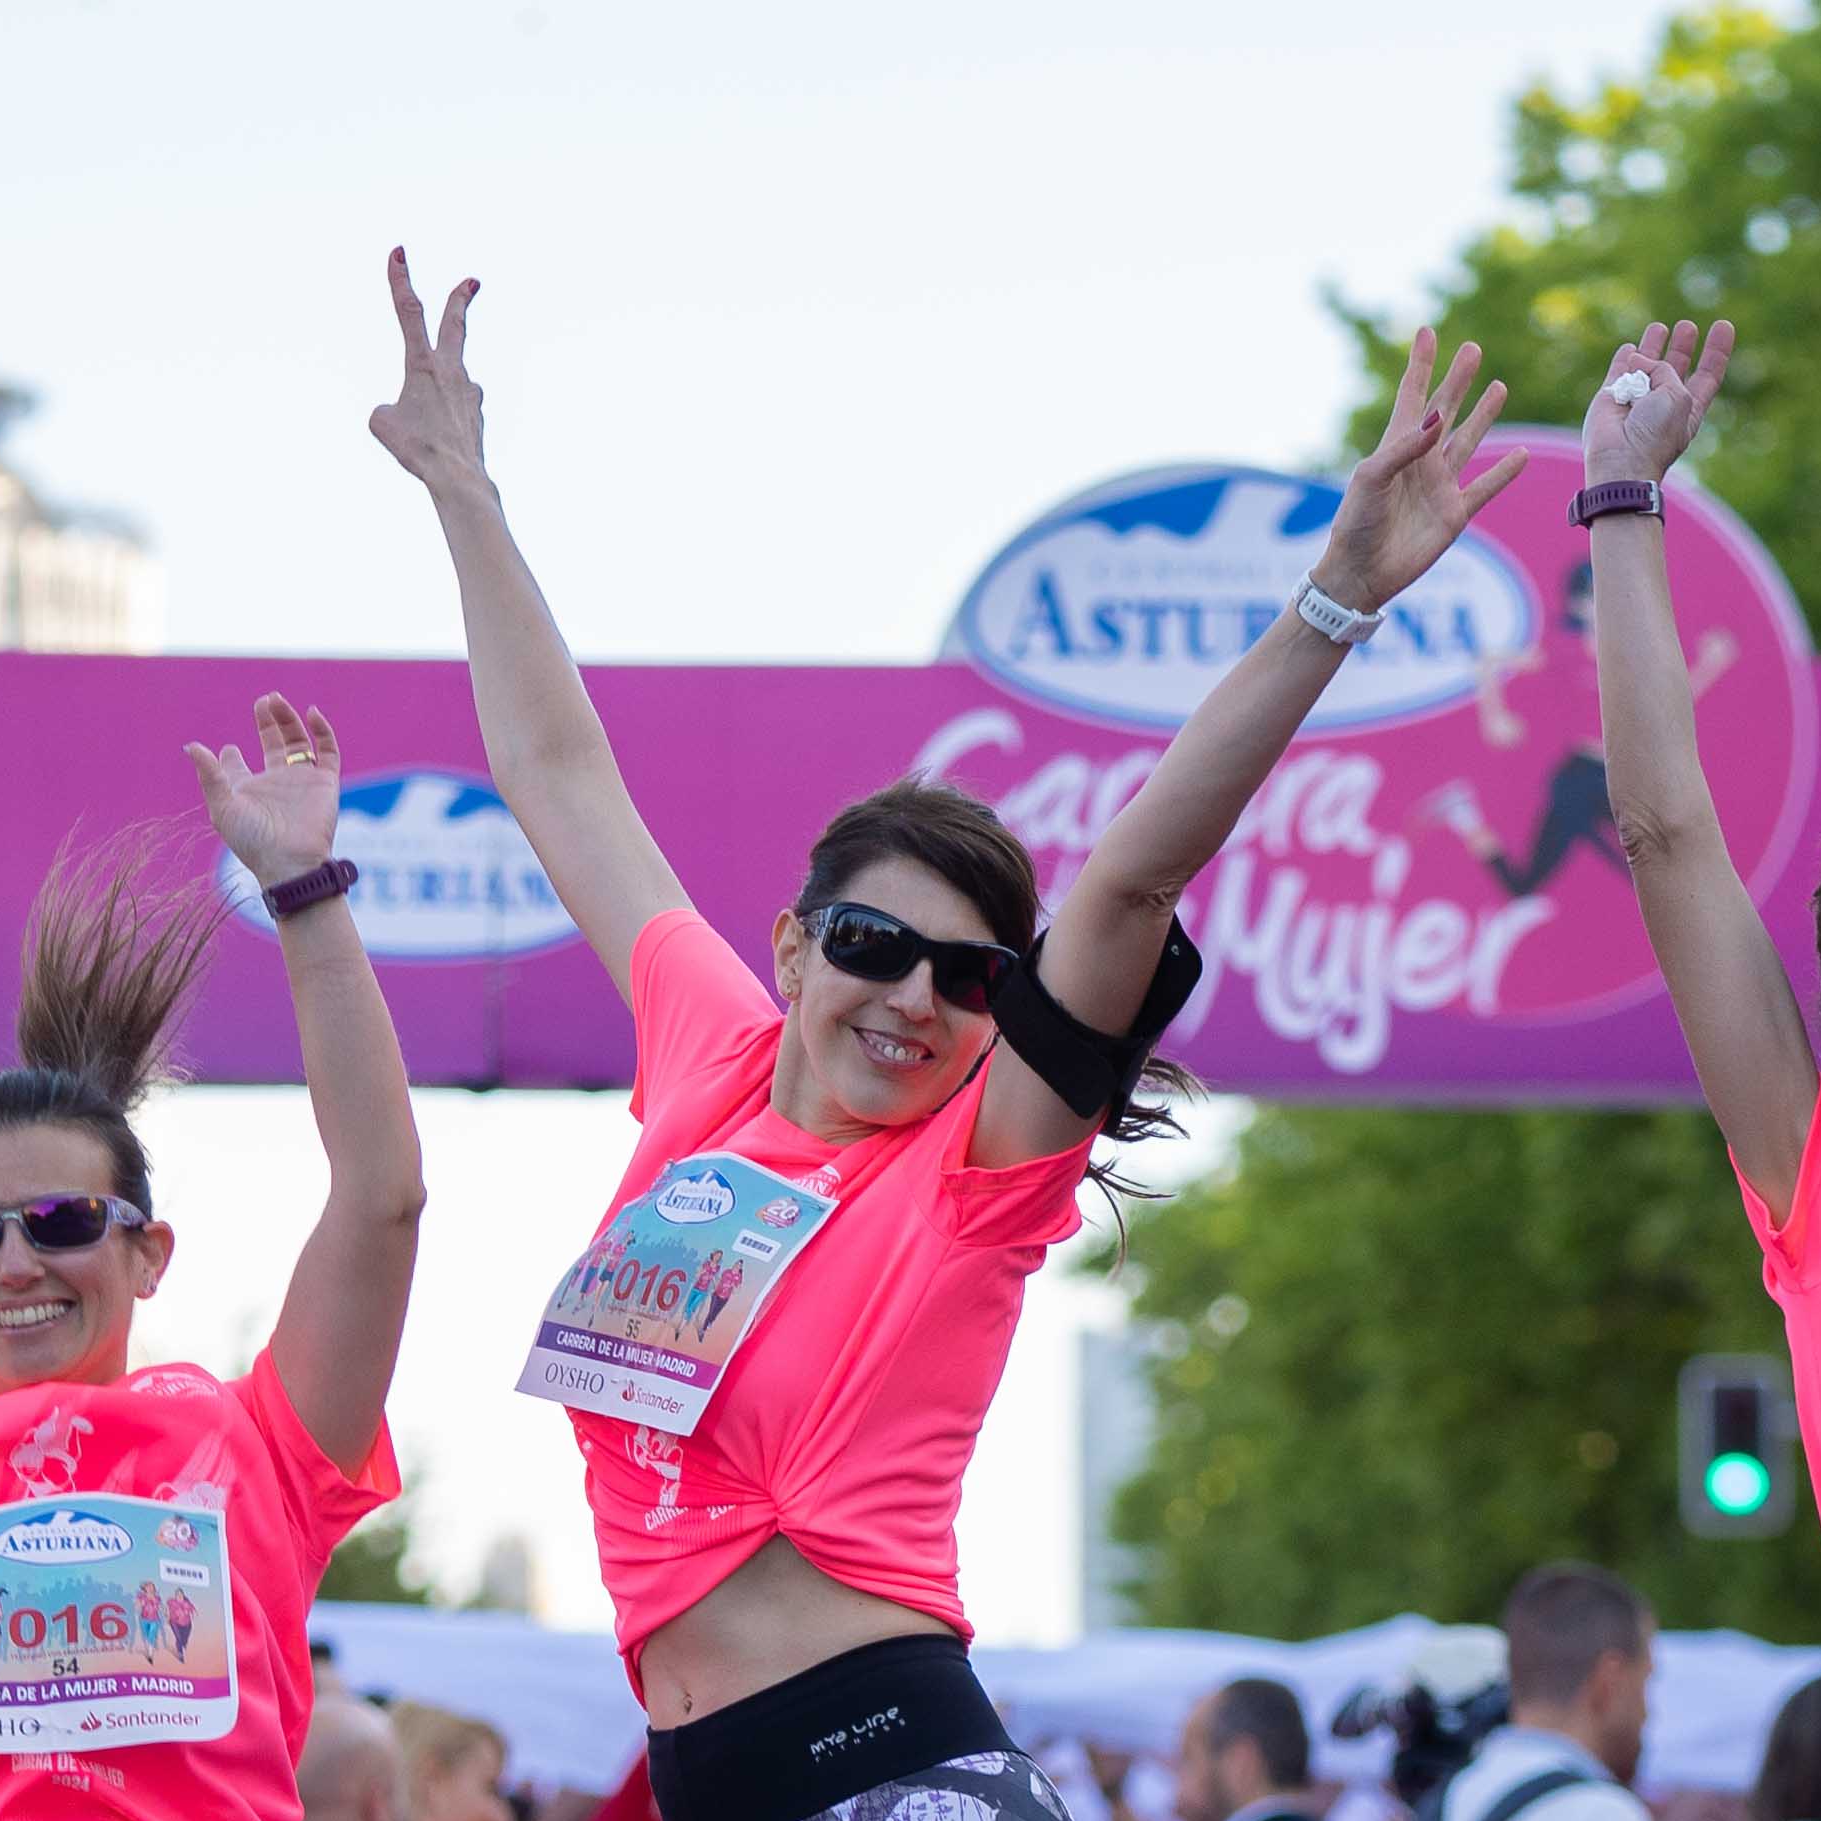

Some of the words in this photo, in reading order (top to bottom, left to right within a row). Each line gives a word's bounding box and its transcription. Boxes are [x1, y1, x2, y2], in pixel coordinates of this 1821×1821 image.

[1176, 838, 1553, 1074] Mujer
[613, 1259, 687, 1311] 016
[626, 1318, 642, 1339] 55
[556, 1331, 596, 1353] CARRERA
[598, 1340, 611, 1357] DE
[613, 1344, 625, 1360] LA
[627, 1347, 656, 1366] MUJER
[545, 1362, 605, 1394] OYSHO
[3, 1534, 123, 1553] ASTURIANA
[9, 1603, 129, 1649] 016
[52, 1658, 81, 1677] 54
[16, 1683, 37, 1702] DE
[41, 1682, 61, 1700] LA
[64, 1679, 118, 1698] MUJER
[132, 1676, 194, 1696] MADRID
[105, 1711, 201, 1733] Santander
